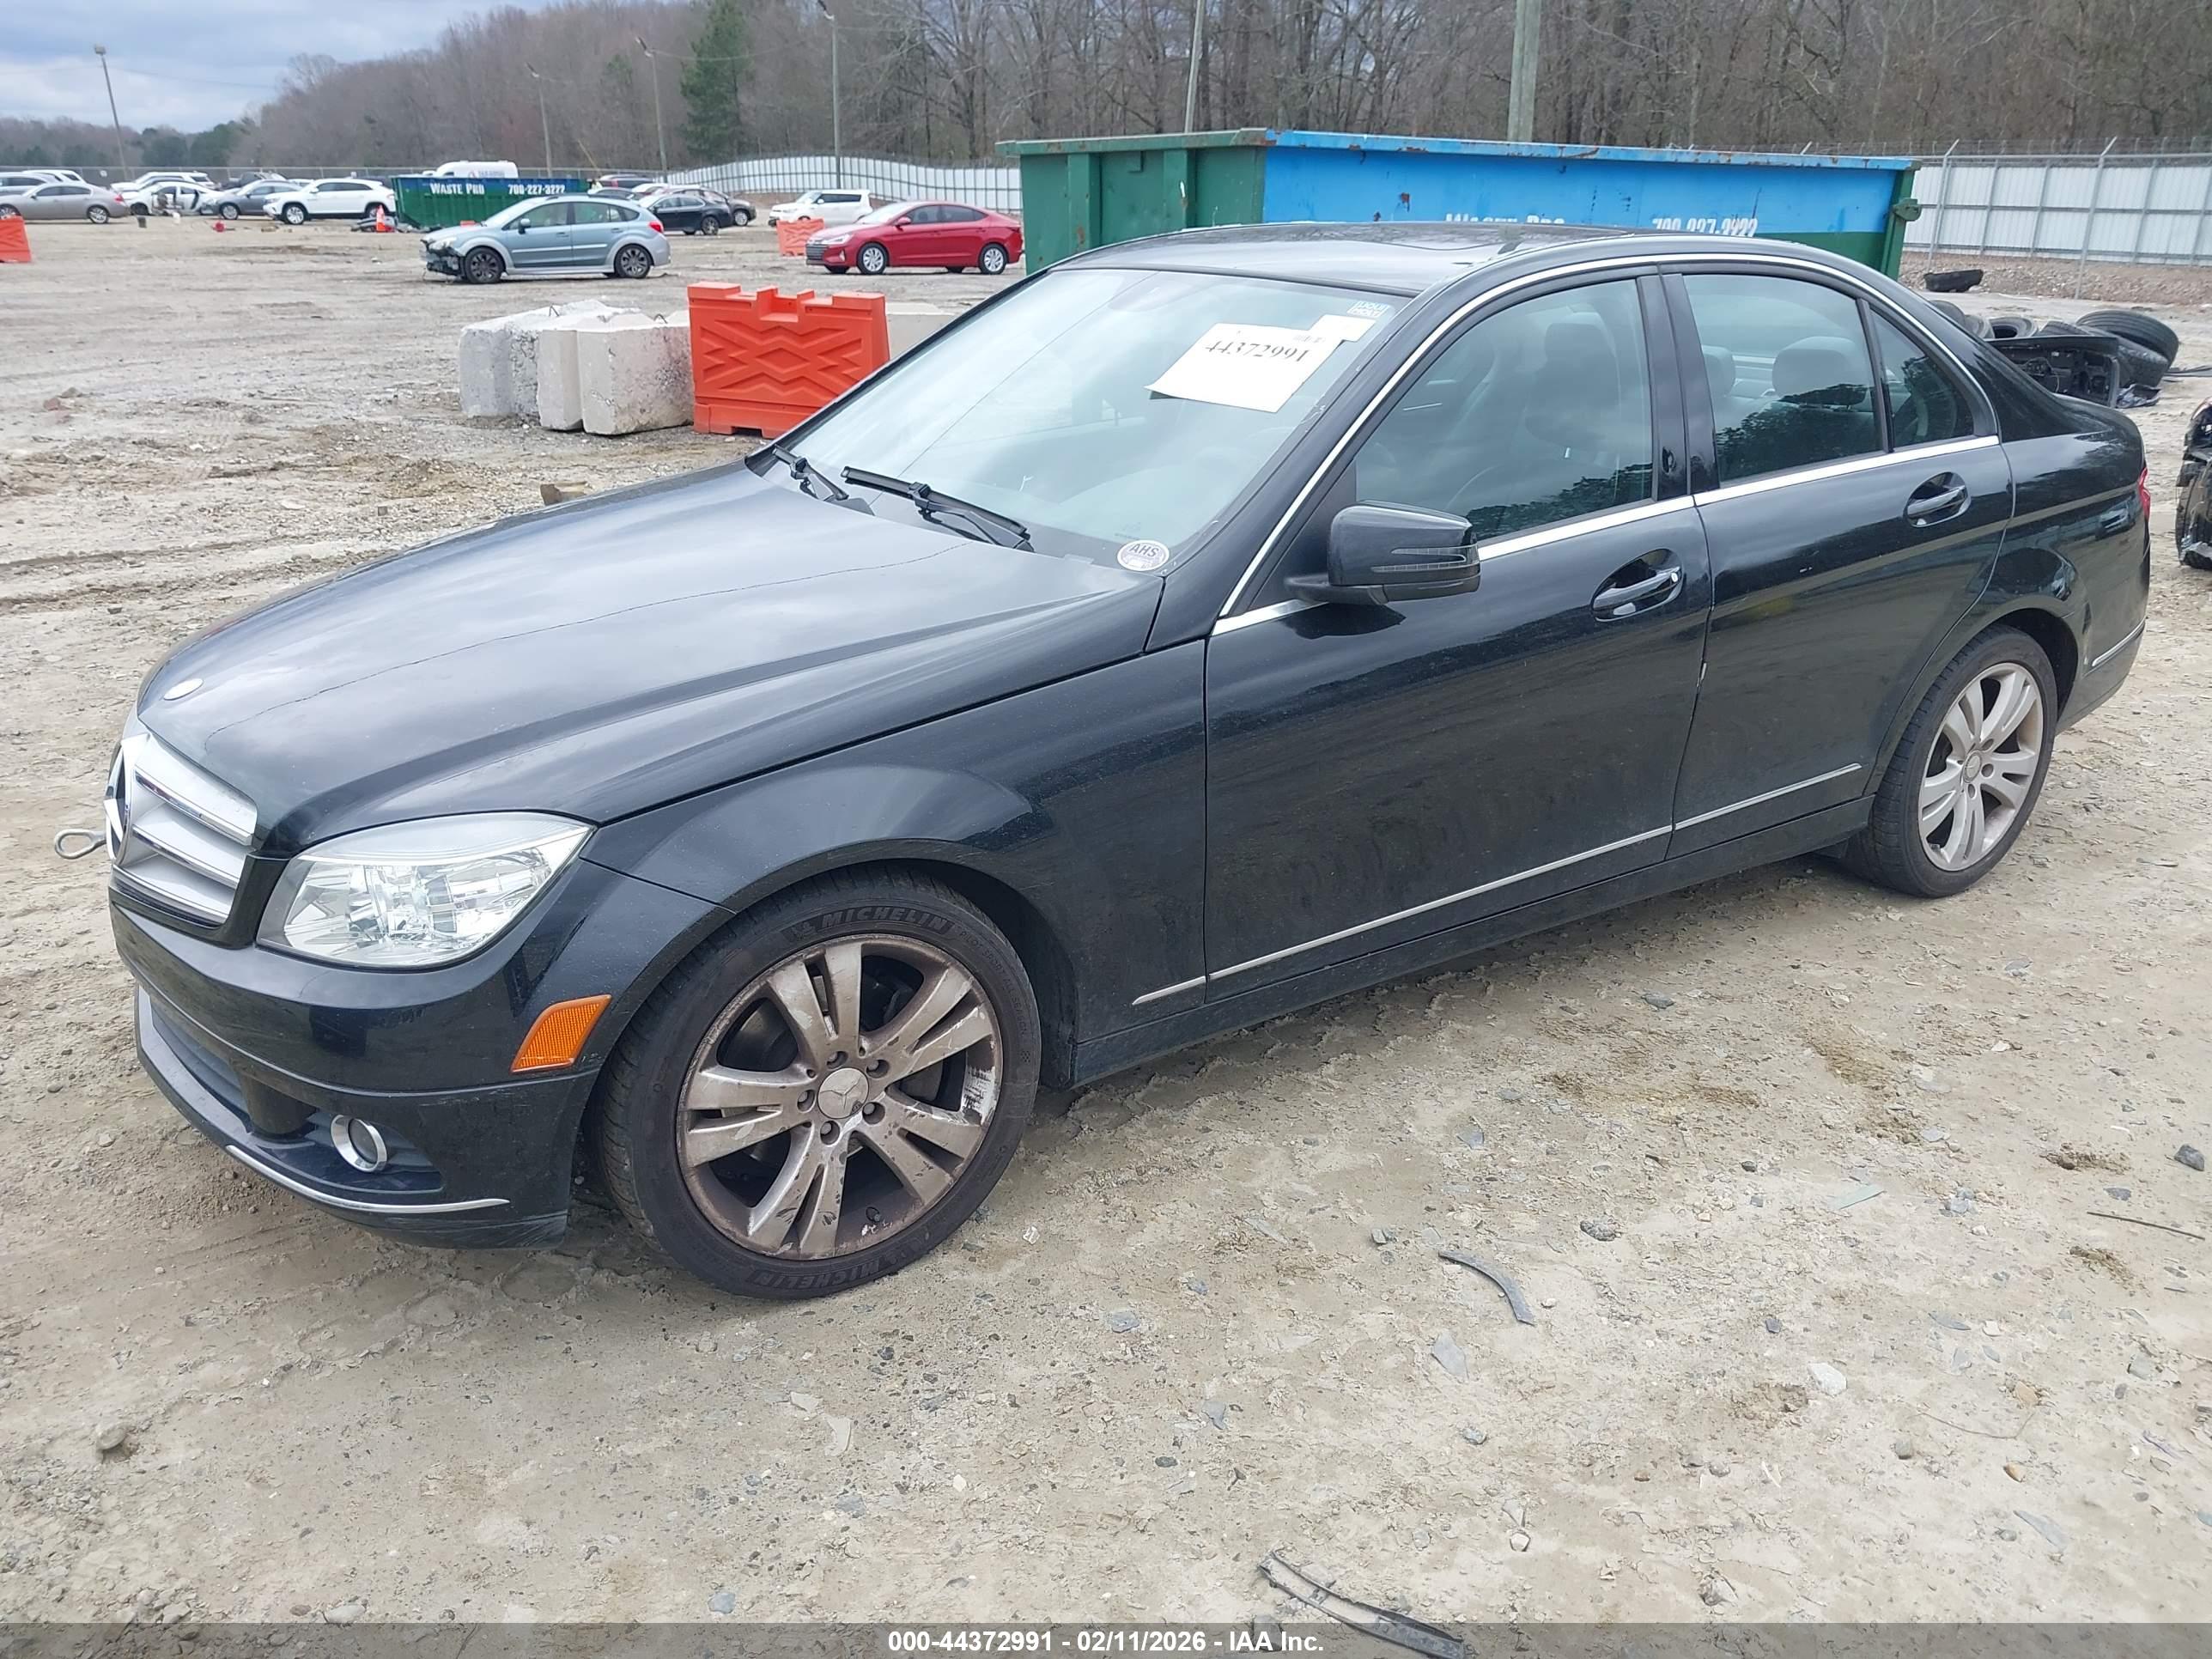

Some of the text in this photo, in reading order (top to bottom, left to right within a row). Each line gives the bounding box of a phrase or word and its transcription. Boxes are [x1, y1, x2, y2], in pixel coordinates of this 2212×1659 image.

[1205, 340, 1310, 362] 44372991
[1129, 544, 1159, 557] AHS
[822, 907, 949, 933] MICHELIN
[753, 1261, 880, 1286] MICHELIN
